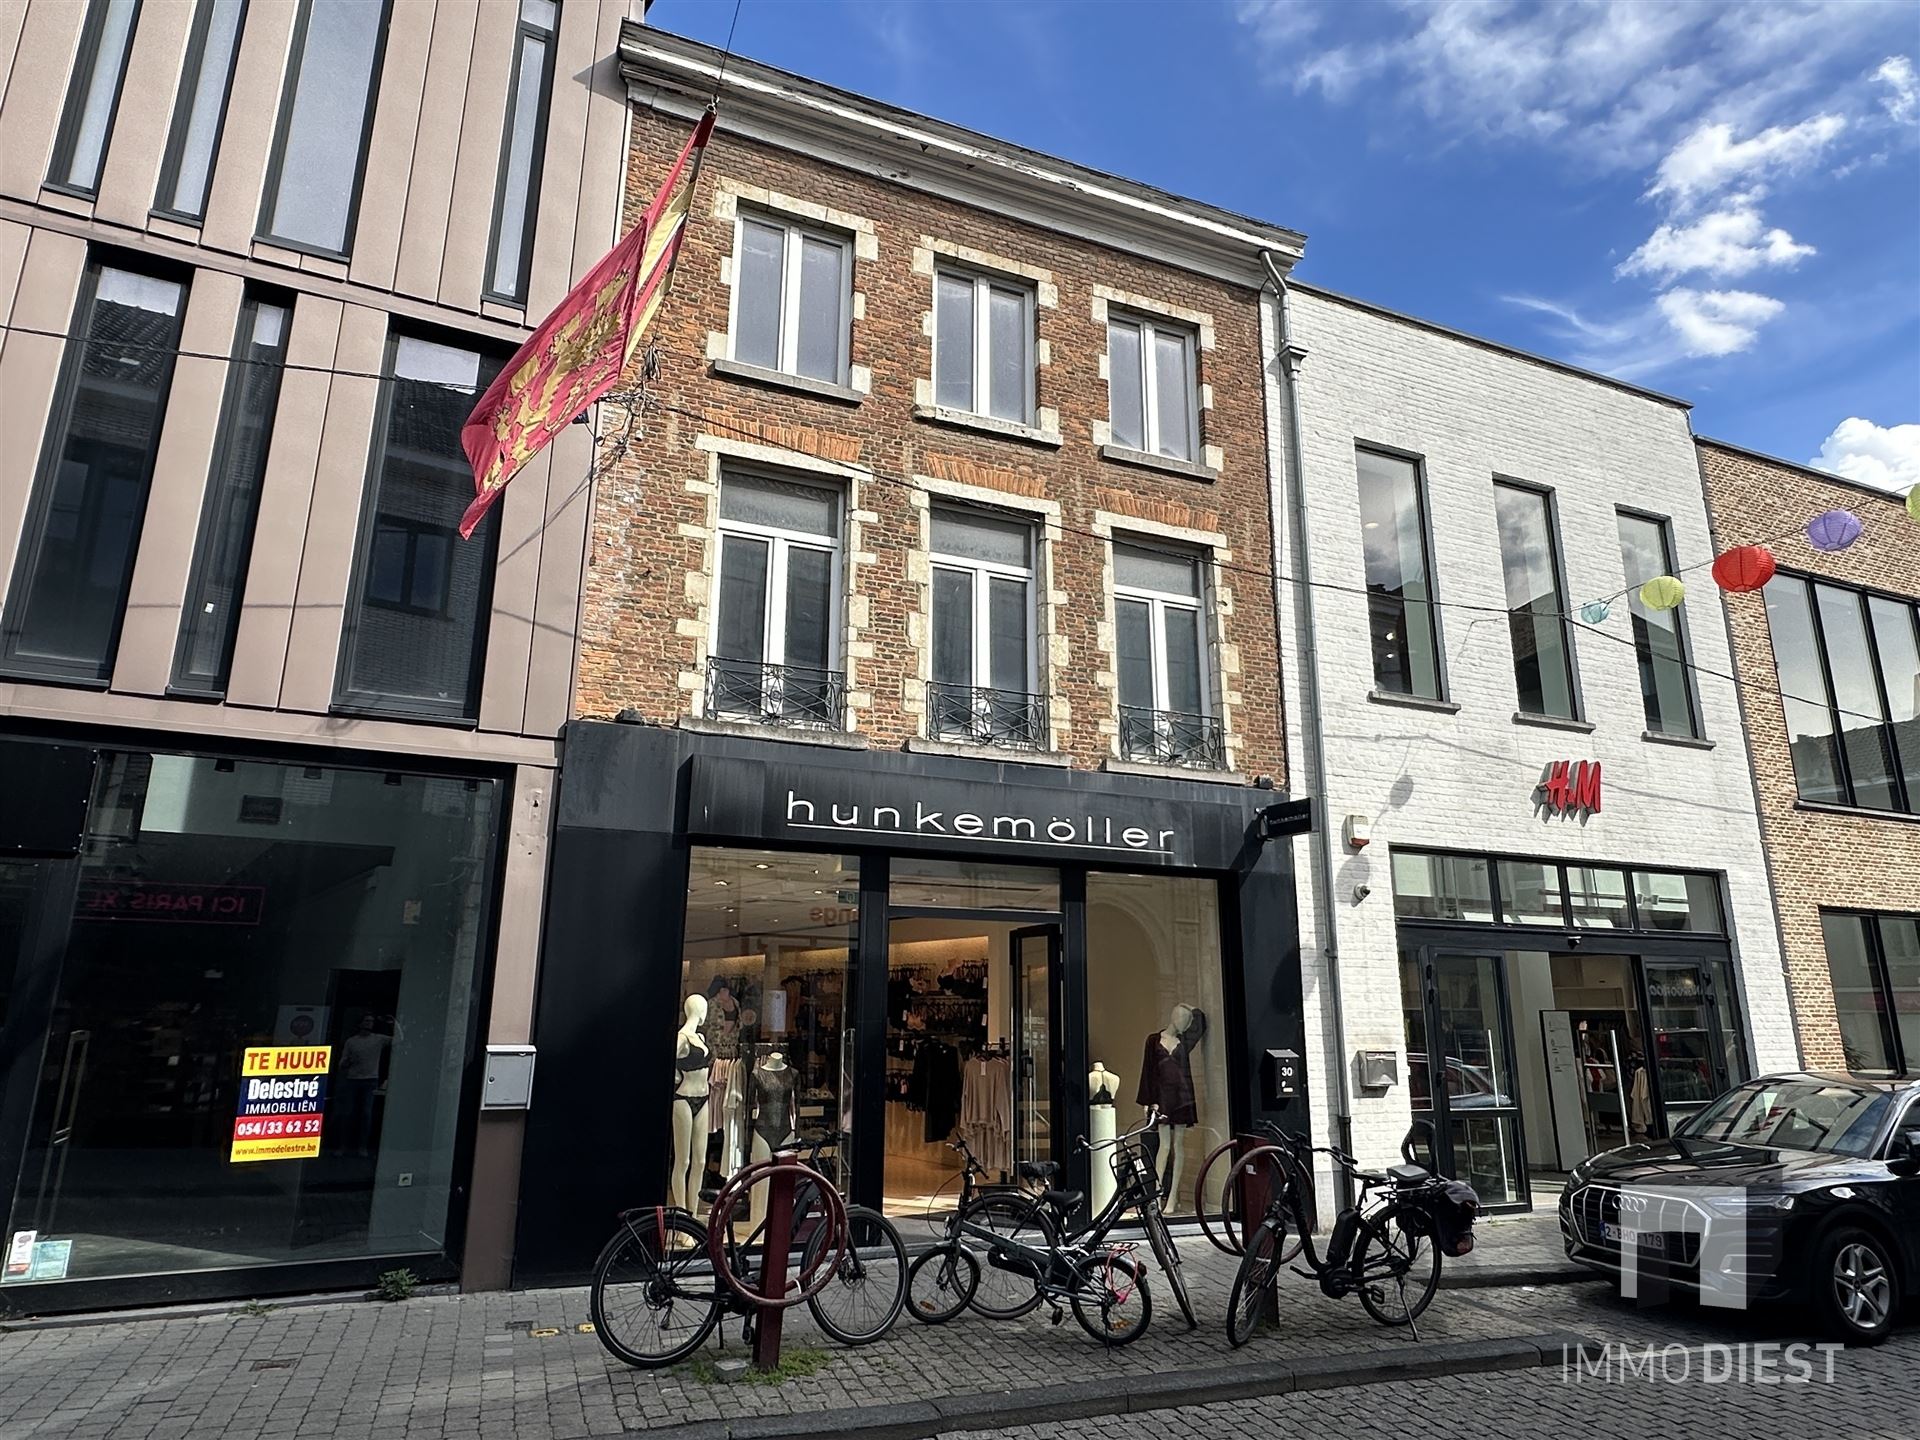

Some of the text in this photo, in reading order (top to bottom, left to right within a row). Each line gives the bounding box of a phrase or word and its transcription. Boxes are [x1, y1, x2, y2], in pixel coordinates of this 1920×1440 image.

[1544, 759, 1602, 814] H&M
[786, 789, 1175, 848] hunkemöller
[248, 1051, 327, 1070] TE HUUR
[1281, 1067, 1293, 1077] 30
[248, 1076, 319, 1101] Delestré
[245, 1101, 317, 1115] IMMOBILIËN
[237, 1119, 320, 1136] 054/33 62 52
[235, 1143, 316, 1155] www.immodelestre.be
